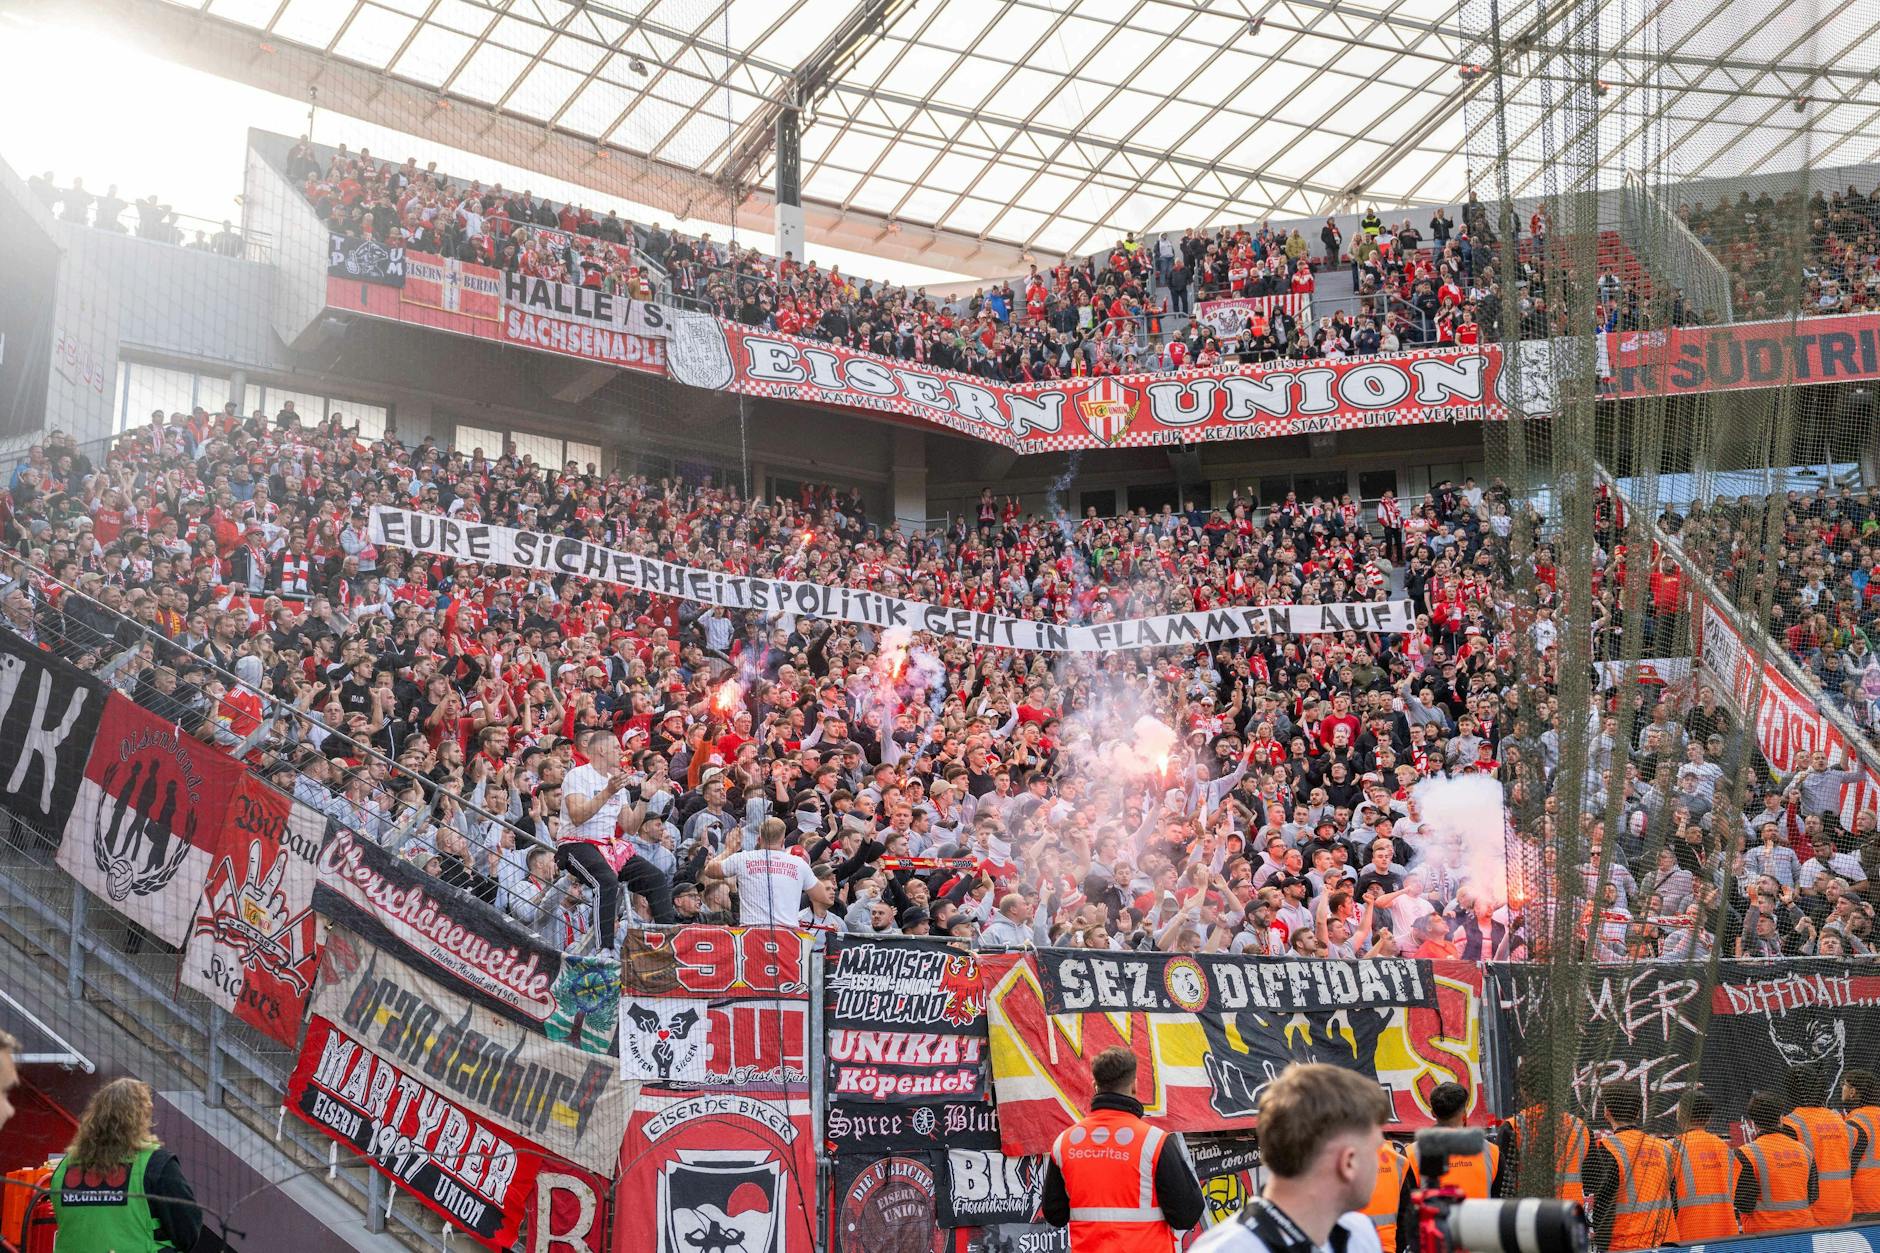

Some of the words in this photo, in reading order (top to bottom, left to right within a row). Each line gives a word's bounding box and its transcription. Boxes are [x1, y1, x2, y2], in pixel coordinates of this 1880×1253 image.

[405, 261, 442, 282] EISERN
[463, 275, 500, 294] BERLIN
[506, 272, 613, 323] HALLE
[1671, 329, 1880, 390] SÜDTRI
[742, 335, 1066, 438] EISERN
[1145, 355, 1489, 427] UNION
[770, 384, 800, 399] WIR
[1290, 415, 1340, 432] STADT
[1364, 411, 1398, 425] UND
[1422, 405, 1486, 422] VEREIN
[380, 512, 490, 559] EURE
[924, 606, 1018, 646] GEHT
[1091, 607, 1292, 650] FLAMMEN
[430, 945, 457, 969] Unions
[1058, 958, 1172, 1009] SEZ.
[1211, 958, 1425, 1009] DIFFIDATI
[829, 1029, 984, 1065] UNIKAT
[834, 1066, 977, 1100] Köpenick
[827, 1107, 903, 1142] Spree
[311, 1091, 363, 1140] EISERN
[433, 1172, 487, 1228] UNION
[1068, 1147, 1130, 1161] Securitas
[62, 1189, 124, 1203] SECURITAS
[852, 1174, 875, 1202] DIE
[882, 1203, 925, 1223] UNION
